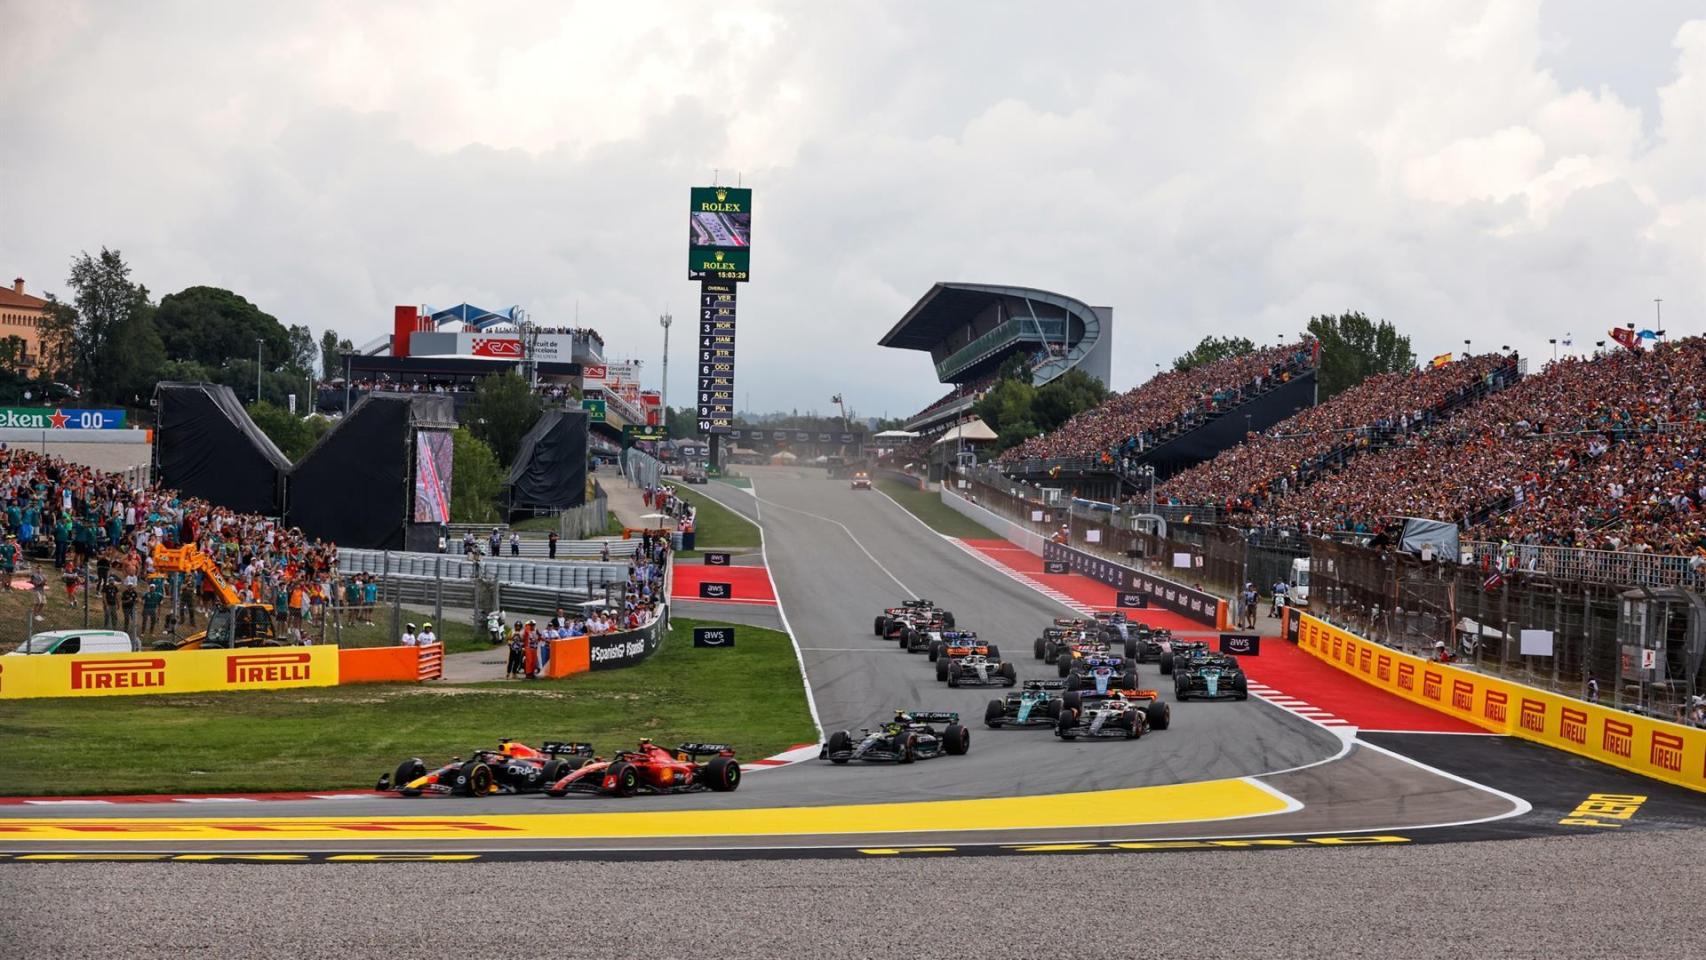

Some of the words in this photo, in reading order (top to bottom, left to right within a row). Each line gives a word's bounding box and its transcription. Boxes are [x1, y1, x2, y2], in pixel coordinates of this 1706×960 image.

[702, 203, 740, 212] ROLEX
[703, 262, 735, 270] ROLEX
[705, 297, 710, 305] 1
[704, 311, 711, 319] 2
[704, 338, 710, 346] 4
[704, 352, 710, 360] 5
[703, 366, 709, 374] 6
[703, 380, 709, 388] 7
[702, 394, 708, 402] 8
[702, 407, 708, 415] 9
[699, 421, 710, 429] 10
[227, 653, 311, 683] PIRELLI
[71, 659, 166, 689] PIRELLI
[1423, 670, 1442, 701] PIRELLI
[1453, 679, 1473, 711] PIRELLI
[1485, 690, 1507, 723] PIRELLI
[1520, 698, 1545, 733] PIRELLI
[1560, 707, 1587, 745] PIRELLI
[1603, 718, 1633, 758] PIRELLI
[1650, 730, 1683, 772] PIRELLI
